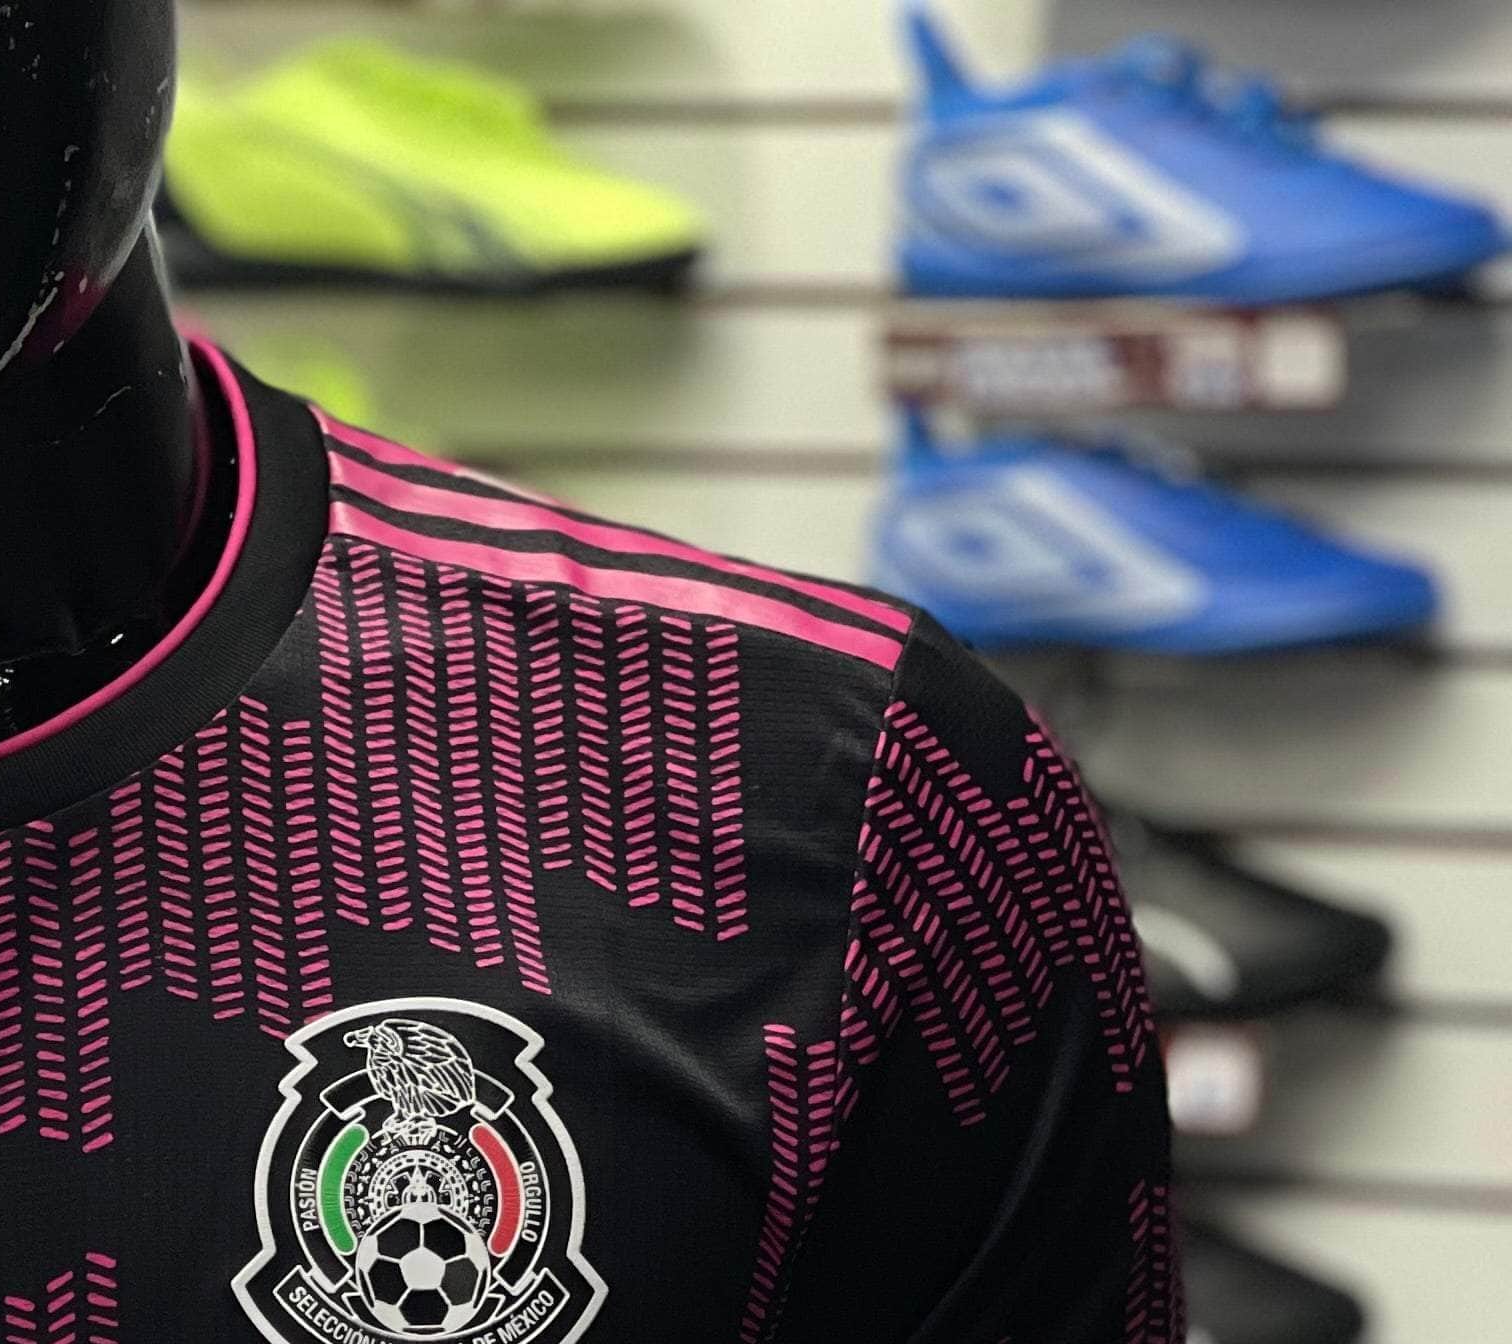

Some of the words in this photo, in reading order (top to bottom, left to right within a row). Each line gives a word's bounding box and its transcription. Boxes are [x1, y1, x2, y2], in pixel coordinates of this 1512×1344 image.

[295, 1168, 319, 1232] PASIÓN
[520, 1161, 542, 1242] ORGULLO
[497, 1290, 554, 1344] MÉXICO
